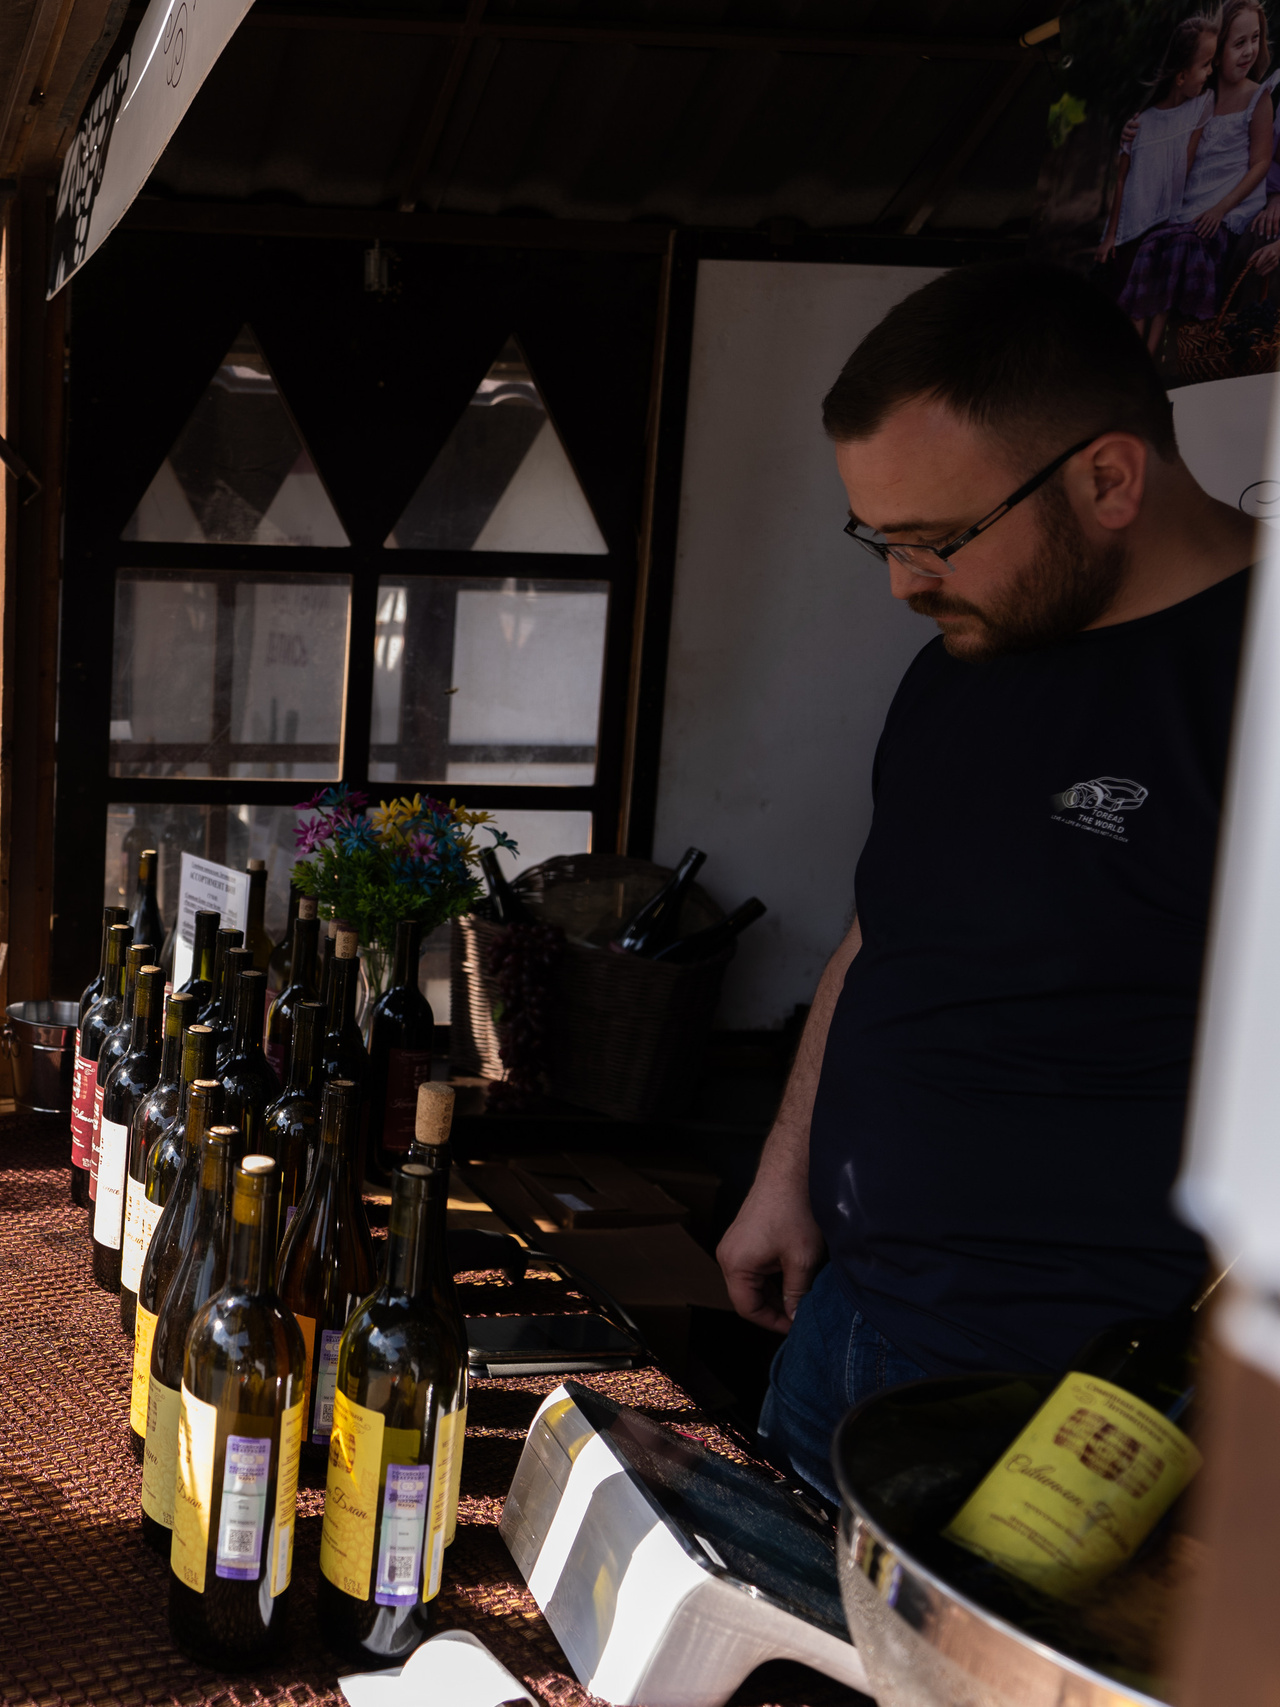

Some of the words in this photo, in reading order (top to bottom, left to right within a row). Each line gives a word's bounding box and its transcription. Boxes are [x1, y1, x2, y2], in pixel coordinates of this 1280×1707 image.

[1078, 814, 1093, 825] THE
[1094, 819, 1125, 834] WORLD
[1092, 809, 1124, 824] TOREAD
[176, 1475, 203, 1511] Блан
[332, 1486, 368, 1520] Блан
